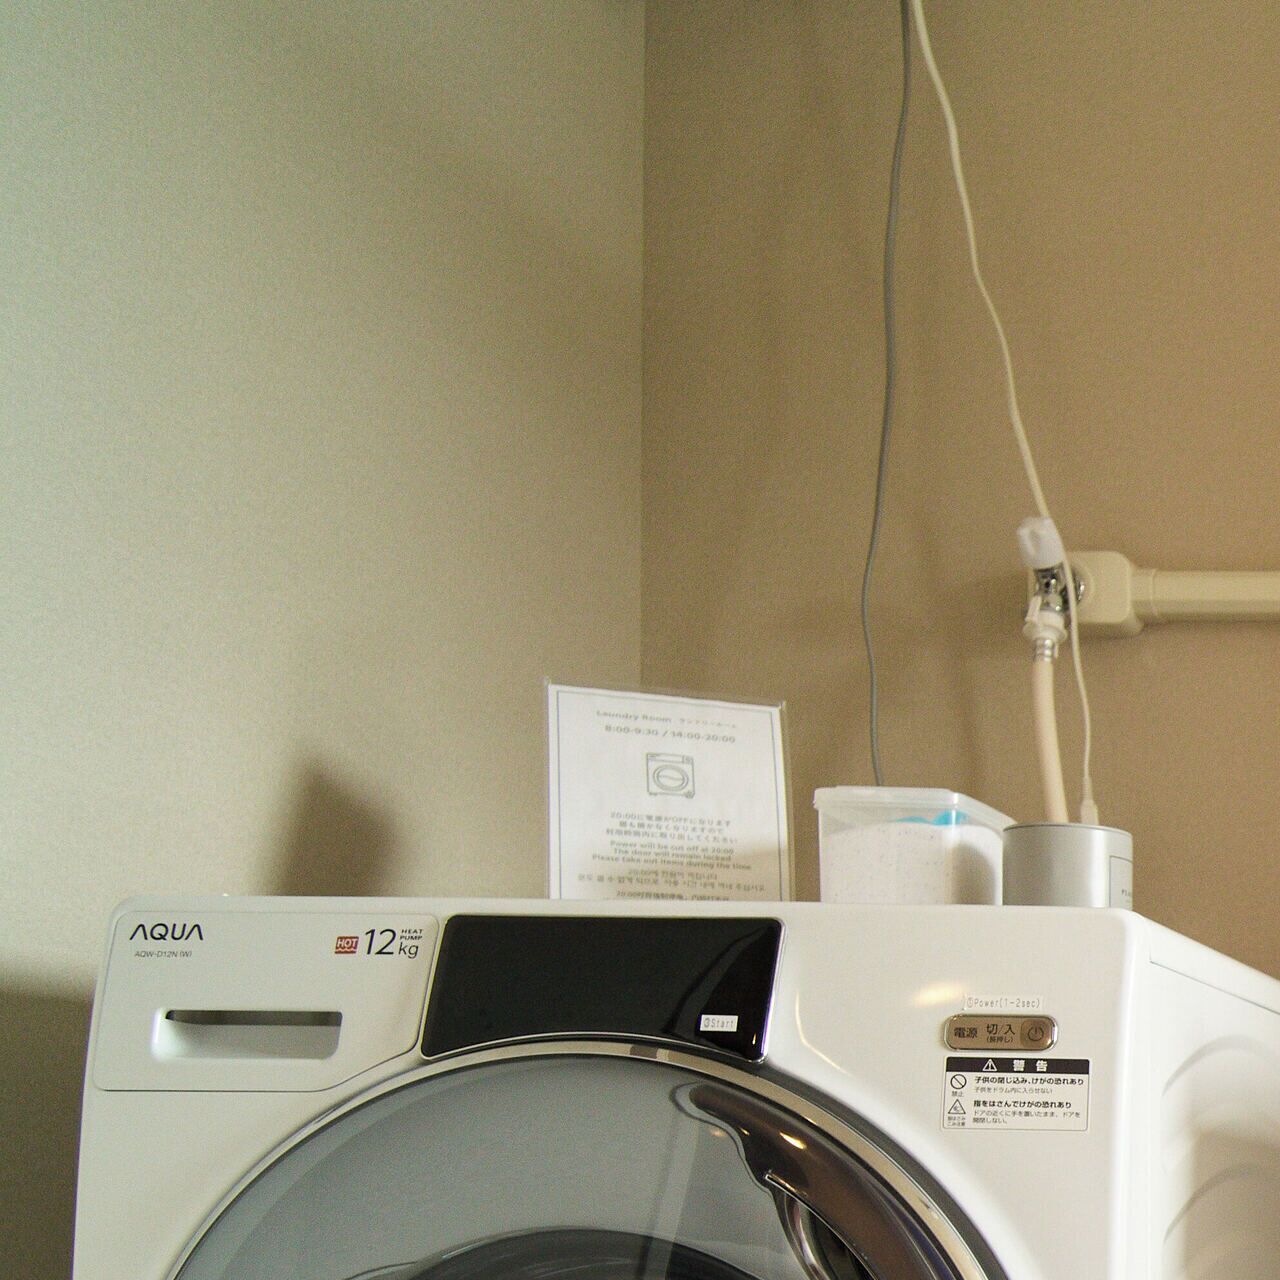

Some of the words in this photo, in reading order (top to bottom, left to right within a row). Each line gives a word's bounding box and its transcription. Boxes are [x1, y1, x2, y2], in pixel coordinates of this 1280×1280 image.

[597, 710, 639, 721] Laundry
[642, 713, 671, 723] Room
[129, 923, 203, 941] AQUA
[337, 938, 358, 948] HOT
[365, 929, 396, 955] 12
[398, 942, 419, 959] kg
[135, 950, 178, 958] AQW-D12N
[954, 1027, 978, 1039] 電源
[986, 1023, 1015, 1035] 切/入
[974, 1100, 1071, 1109] 指をはさんでけがの恐れあり
